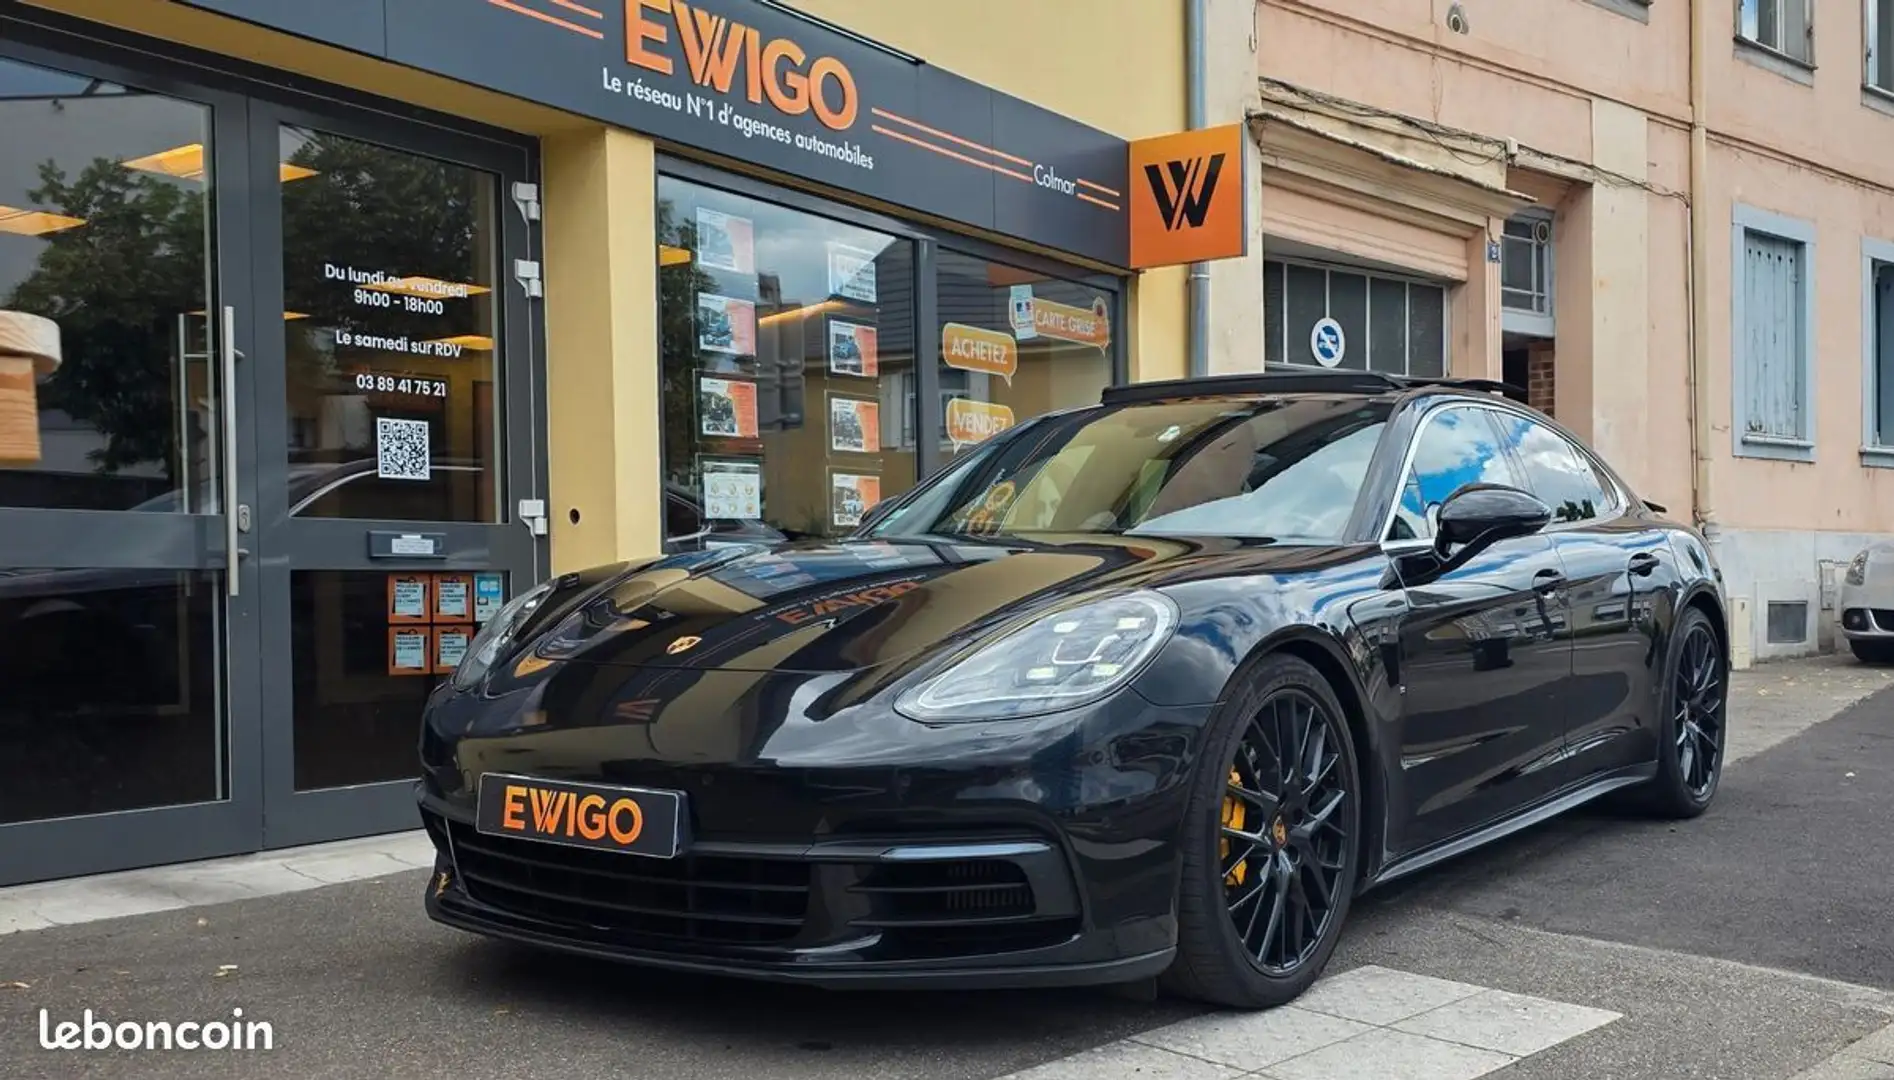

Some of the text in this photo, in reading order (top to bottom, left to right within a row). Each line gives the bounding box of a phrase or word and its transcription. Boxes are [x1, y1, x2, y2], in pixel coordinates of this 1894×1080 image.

[625, 0, 858, 130] EWIGO
[603, 67, 874, 169] Le réseau N°1 d'agences automobiles
[1034, 164, 1075, 195] Colmar
[324, 264, 345, 280] Du
[348, 267, 384, 285] lundi
[354, 289, 390, 308] 9h00
[404, 297, 443, 315] 18h00
[1035, 308, 1066, 331] CARTE
[336, 330, 462, 358] Le samedi sur RDV
[951, 338, 1008, 365] ACHETEZ
[356, 374, 446, 397] 03 89 41 75 21
[954, 409, 1008, 433] VENDEZ
[503, 785, 643, 845] EWIGO
